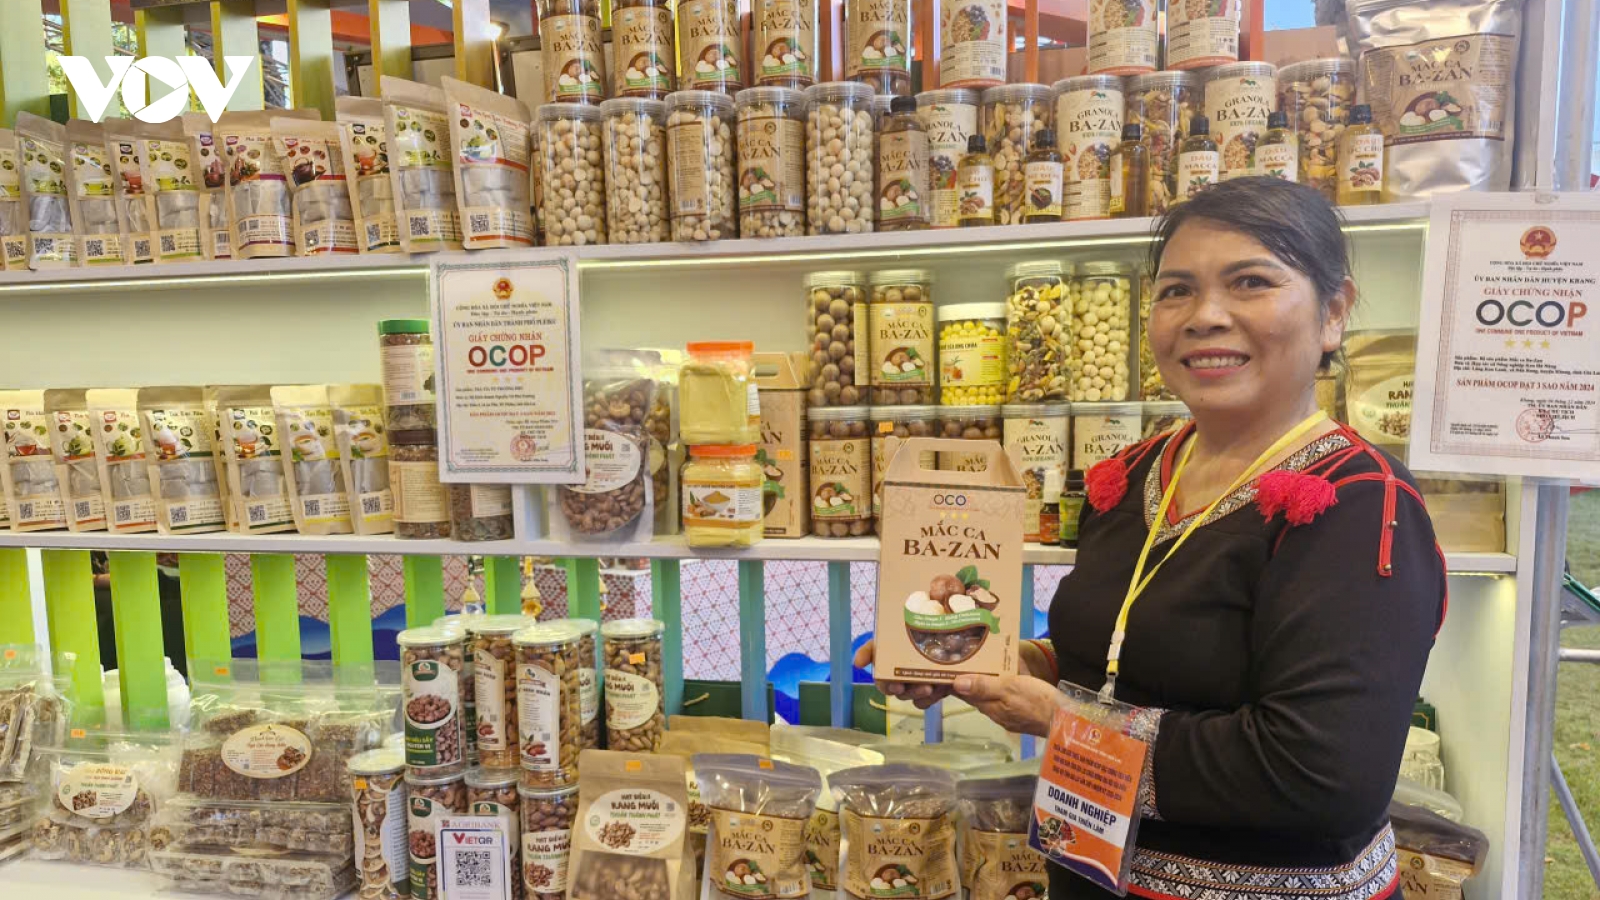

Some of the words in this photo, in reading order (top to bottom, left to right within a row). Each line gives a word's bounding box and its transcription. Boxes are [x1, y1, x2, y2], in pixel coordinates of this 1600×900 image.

[1399, 65, 1473, 87] BA-ZAN
[1216, 106, 1272, 122] BA-ZA
[741, 146, 781, 161] A-ZAN
[1476, 299, 1588, 328] OCOP
[468, 344, 546, 367] OCOP
[1496, 380, 1520, 389] OCOP
[920, 519, 959, 538] MẮC
[963, 527, 986, 541] CA
[903, 538, 1001, 560] BA-ZAN
[610, 800, 636, 811] RANG
[638, 799, 660, 811] MUỐI
[1047, 785, 1080, 810] DOANH
[1080, 800, 1117, 827] NGHIỆP
[721, 836, 776, 855] BA-ZAN
[867, 843, 925, 856] BA-ZAN
